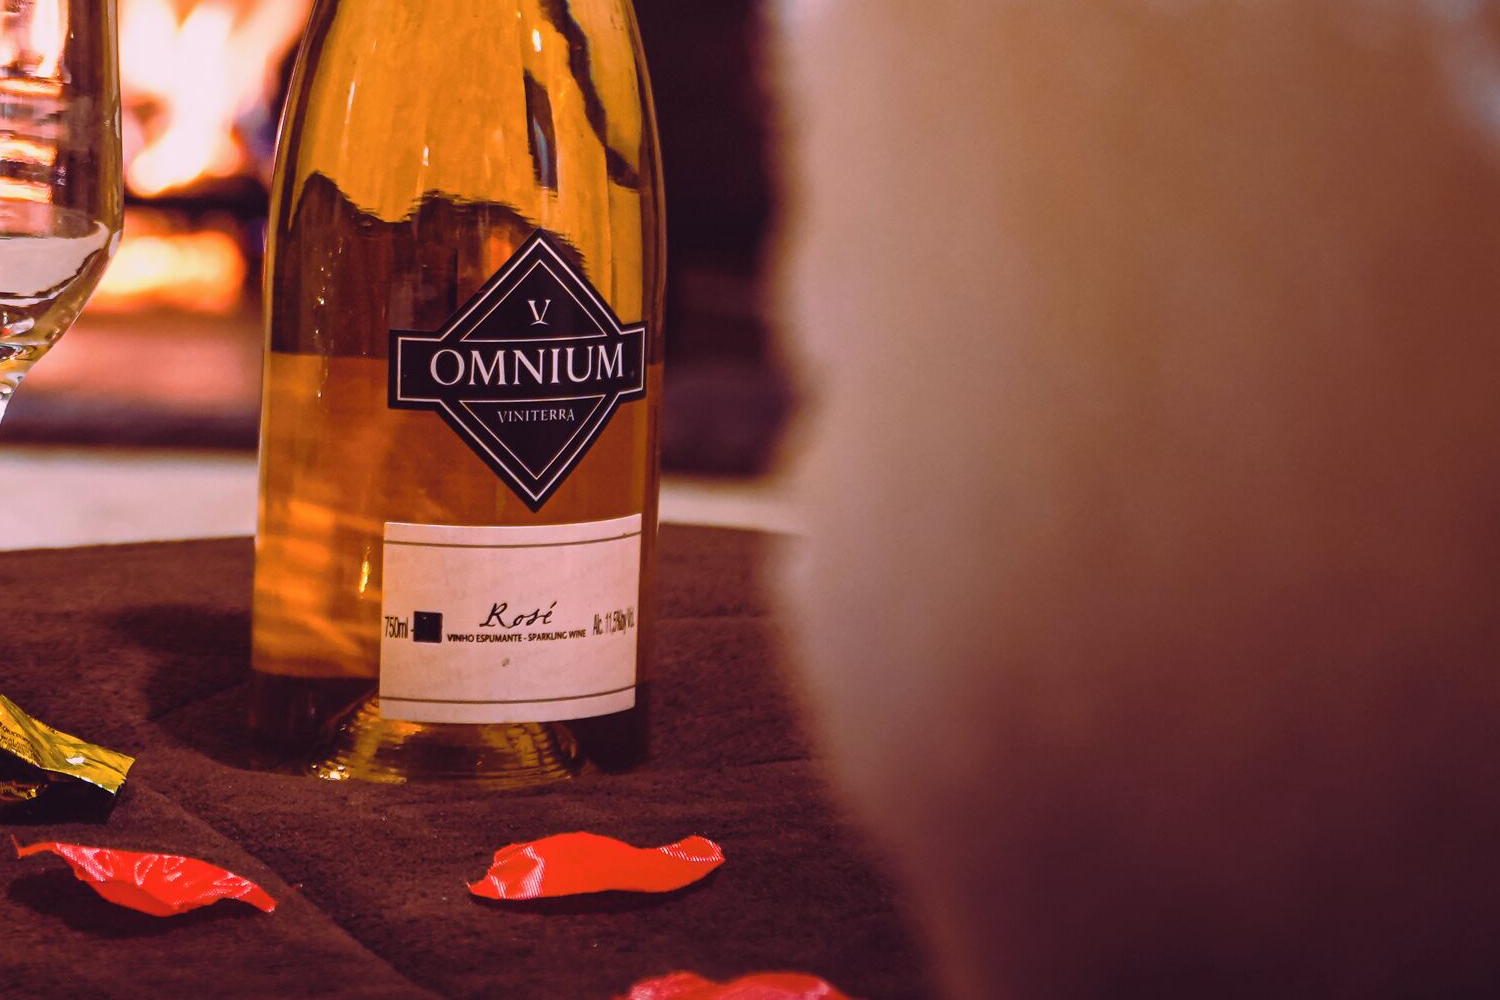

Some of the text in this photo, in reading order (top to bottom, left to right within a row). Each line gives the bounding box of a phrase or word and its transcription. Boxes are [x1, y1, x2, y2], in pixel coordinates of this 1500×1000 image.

[430, 342, 625, 386] OMNIUM
[497, 408, 575, 424] VINITERRA
[479, 601, 557, 629] Rosé
[384, 616, 408, 639] 750ml
[447, 634, 474, 642] VINHO
[476, 634, 522, 642] ESPUMANTE
[528, 631, 567, 642] SPARKLING
[569, 629, 587, 639] WINE
